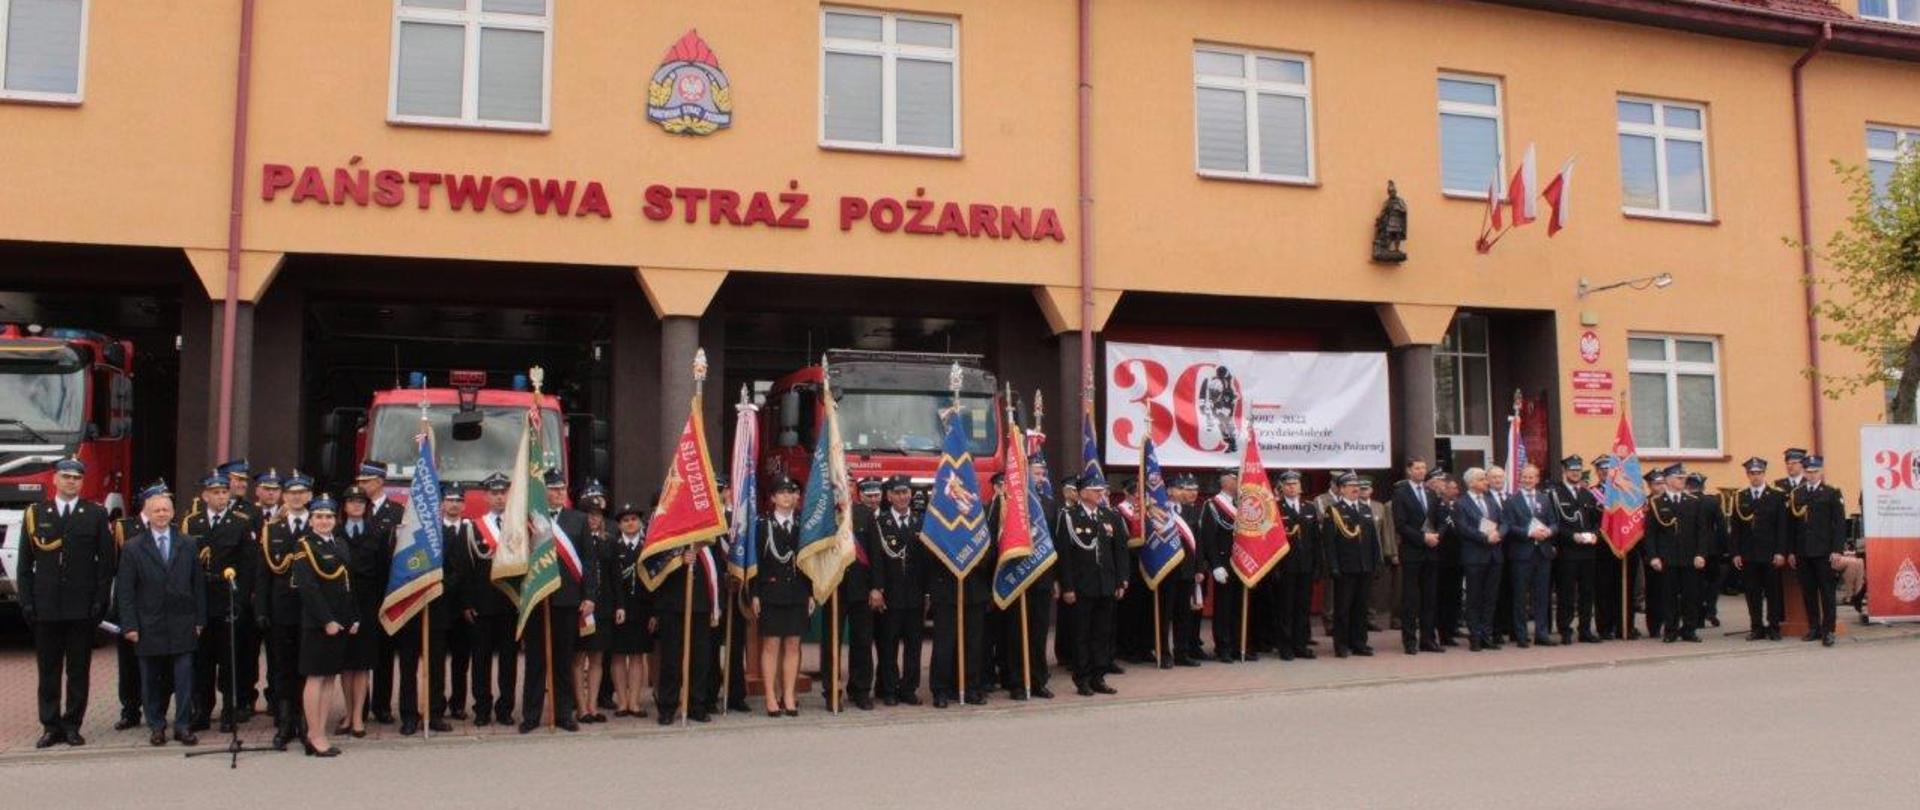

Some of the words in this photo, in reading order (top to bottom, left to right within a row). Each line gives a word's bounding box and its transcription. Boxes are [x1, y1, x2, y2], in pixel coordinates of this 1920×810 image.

[262, 156, 612, 218] PAŃSTWOWA
[643, 180, 809, 229] STRAŻ
[840, 187, 1066, 242] POŻARNA
[1112, 358, 1243, 452] 30
[1257, 428, 1333, 439] rzydziestolecie
